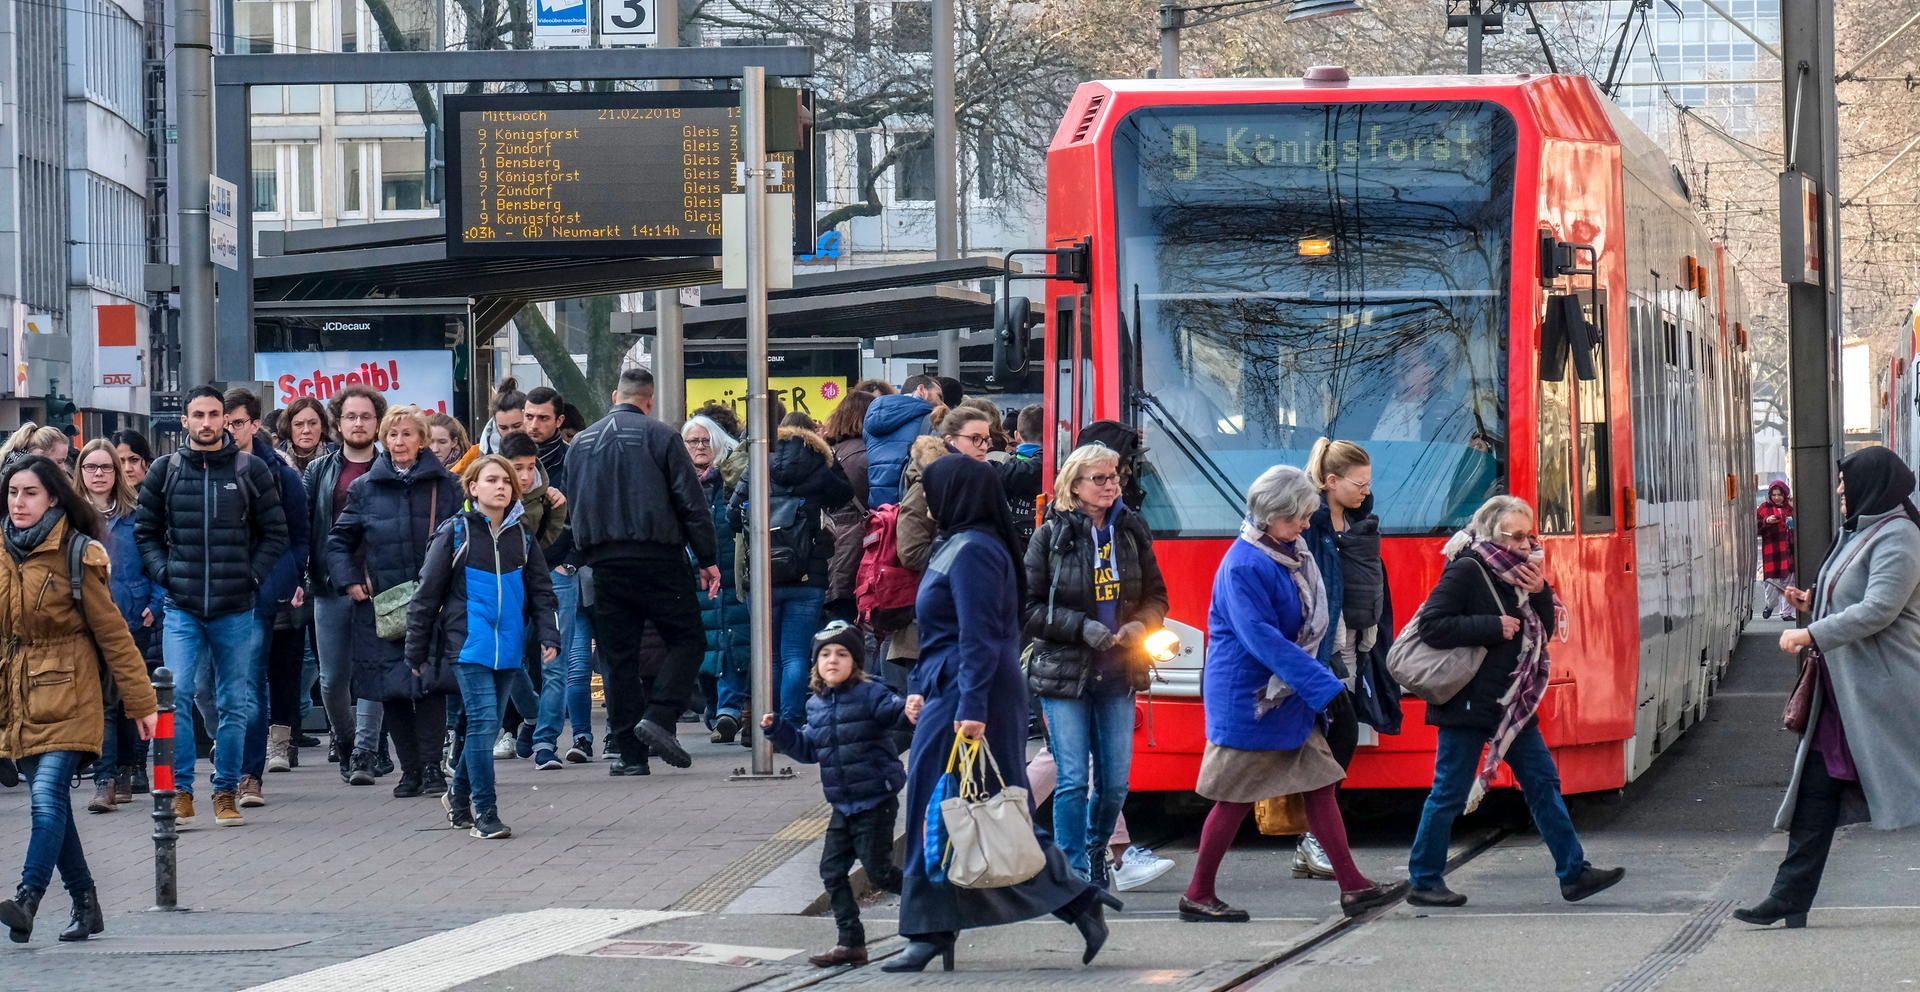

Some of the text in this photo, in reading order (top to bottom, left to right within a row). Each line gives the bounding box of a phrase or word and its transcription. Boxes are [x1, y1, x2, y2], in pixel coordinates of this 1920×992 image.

[611, 0, 646, 28] 3
[482, 111, 547, 121] Mittwoch
[598, 107, 681, 120] 21.02.2018
[478, 125, 738, 143] 9 Königsforst Gleis 3
[479, 140, 738, 156] 7 Zündorf Gleis 3
[1172, 123, 1472, 181] 9 Königsforst
[480, 158, 486, 168] 1
[496, 157, 560, 170] Bensberg
[683, 154, 720, 166] Gleis
[479, 172, 487, 183] 9
[496, 170, 580, 186] Königsforst
[683, 168, 720, 179] Gleis
[480, 186, 487, 196] 7
[497, 184, 552, 198] Zündorf
[684, 182, 720, 194] Gleis
[731, 181, 739, 193] 3
[480, 196, 720, 212] 1 Bensberg Gleis
[480, 210, 721, 227] 9 Königsforst Gleis
[462, 228, 495, 238] :03h
[553, 225, 621, 237] Neumarkt
[631, 225, 680, 238] 14:14h
[323, 322, 370, 331] JCDecaux
[104, 374, 131, 384] DAK
[278, 359, 401, 404] Schreib!
